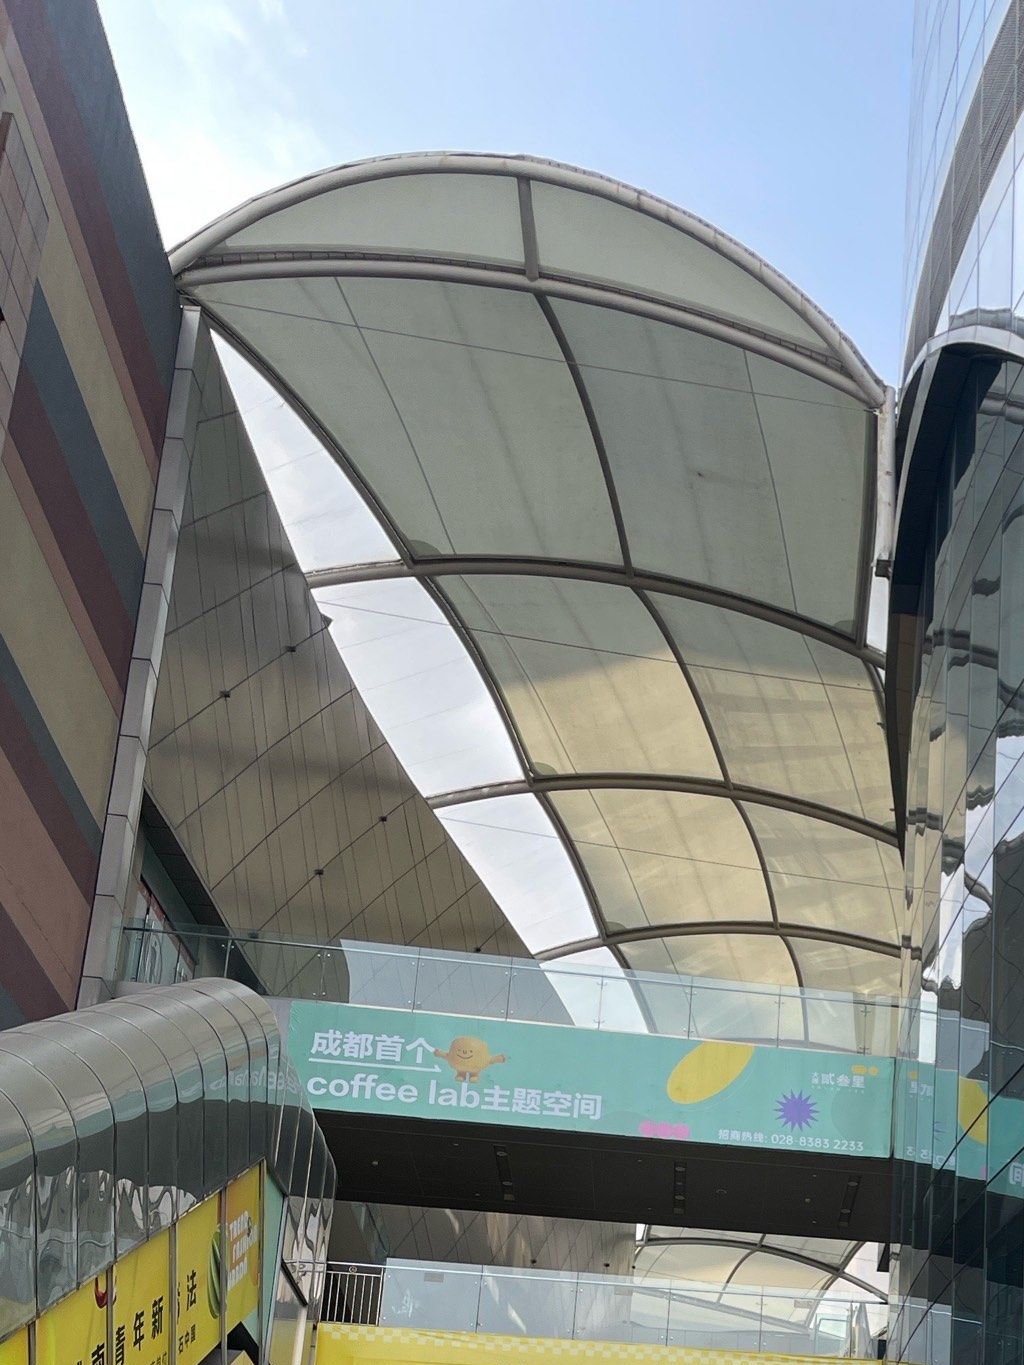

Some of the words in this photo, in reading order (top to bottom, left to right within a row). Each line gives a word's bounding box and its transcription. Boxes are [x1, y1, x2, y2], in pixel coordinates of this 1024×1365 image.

[310, 1028, 436, 1064] 成都首个
[307, 1073, 418, 1103] coffee
[771, 1134, 830, 1149] 028-8383
[833, 1139, 864, 1152] 2233
